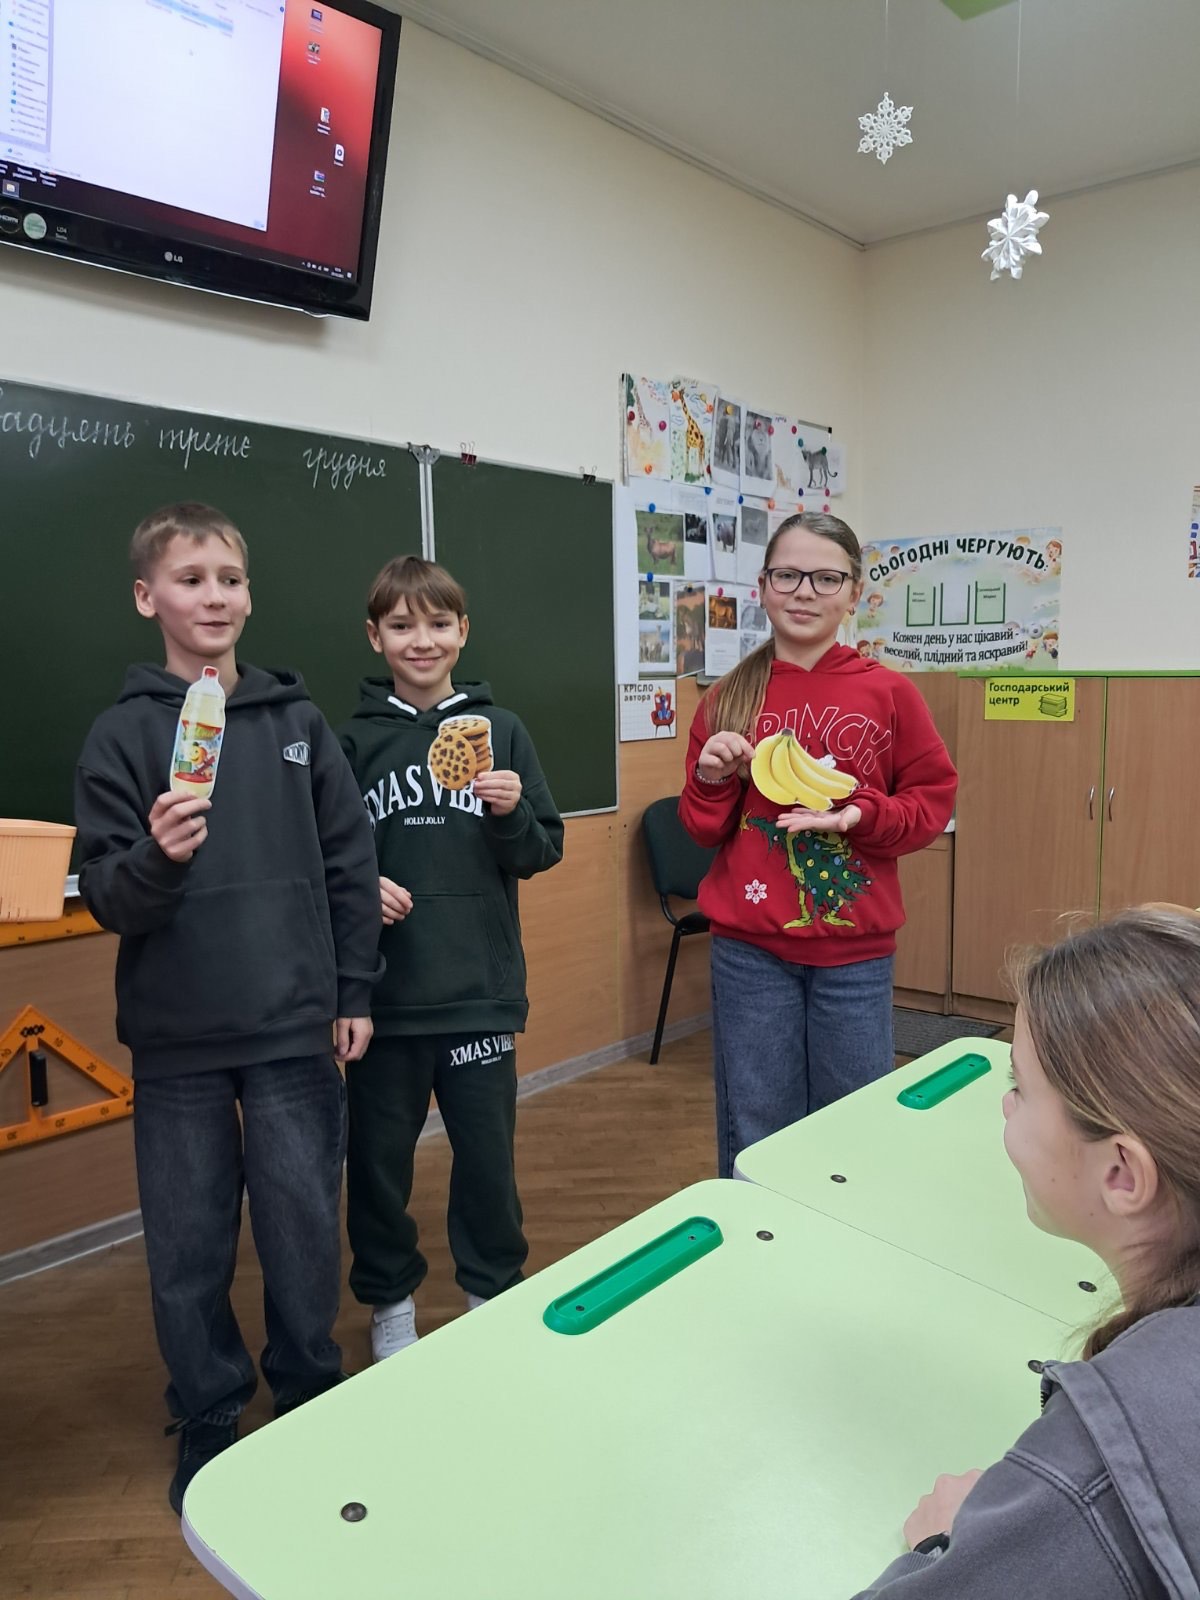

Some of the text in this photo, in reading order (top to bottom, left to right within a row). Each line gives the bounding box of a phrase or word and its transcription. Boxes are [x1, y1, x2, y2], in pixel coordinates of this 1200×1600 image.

[0, 392, 135, 458] адцять
[303, 448, 386, 490] грудня
[869, 538, 1049, 581] СЬОГОДНІ ЧЕРГУЮТЬ:
[893, 631, 922, 644] Кожен
[924, 633, 947, 646] день
[948, 634, 955, 648] у
[956, 633, 972, 644] нас
[974, 628, 1014, 645] цікавий
[884, 641, 1028, 665] веселий, плідний та яскравий!
[624, 684, 654, 693] КРІСЛО
[989, 682, 1070, 694] Господарський
[624, 694, 651, 704] автора
[989, 696, 1020, 706] центр
[749, 703, 892, 776] RINCH
[404, 816, 425, 826] HOLLY
[450, 1038, 492, 1067] XMAS
